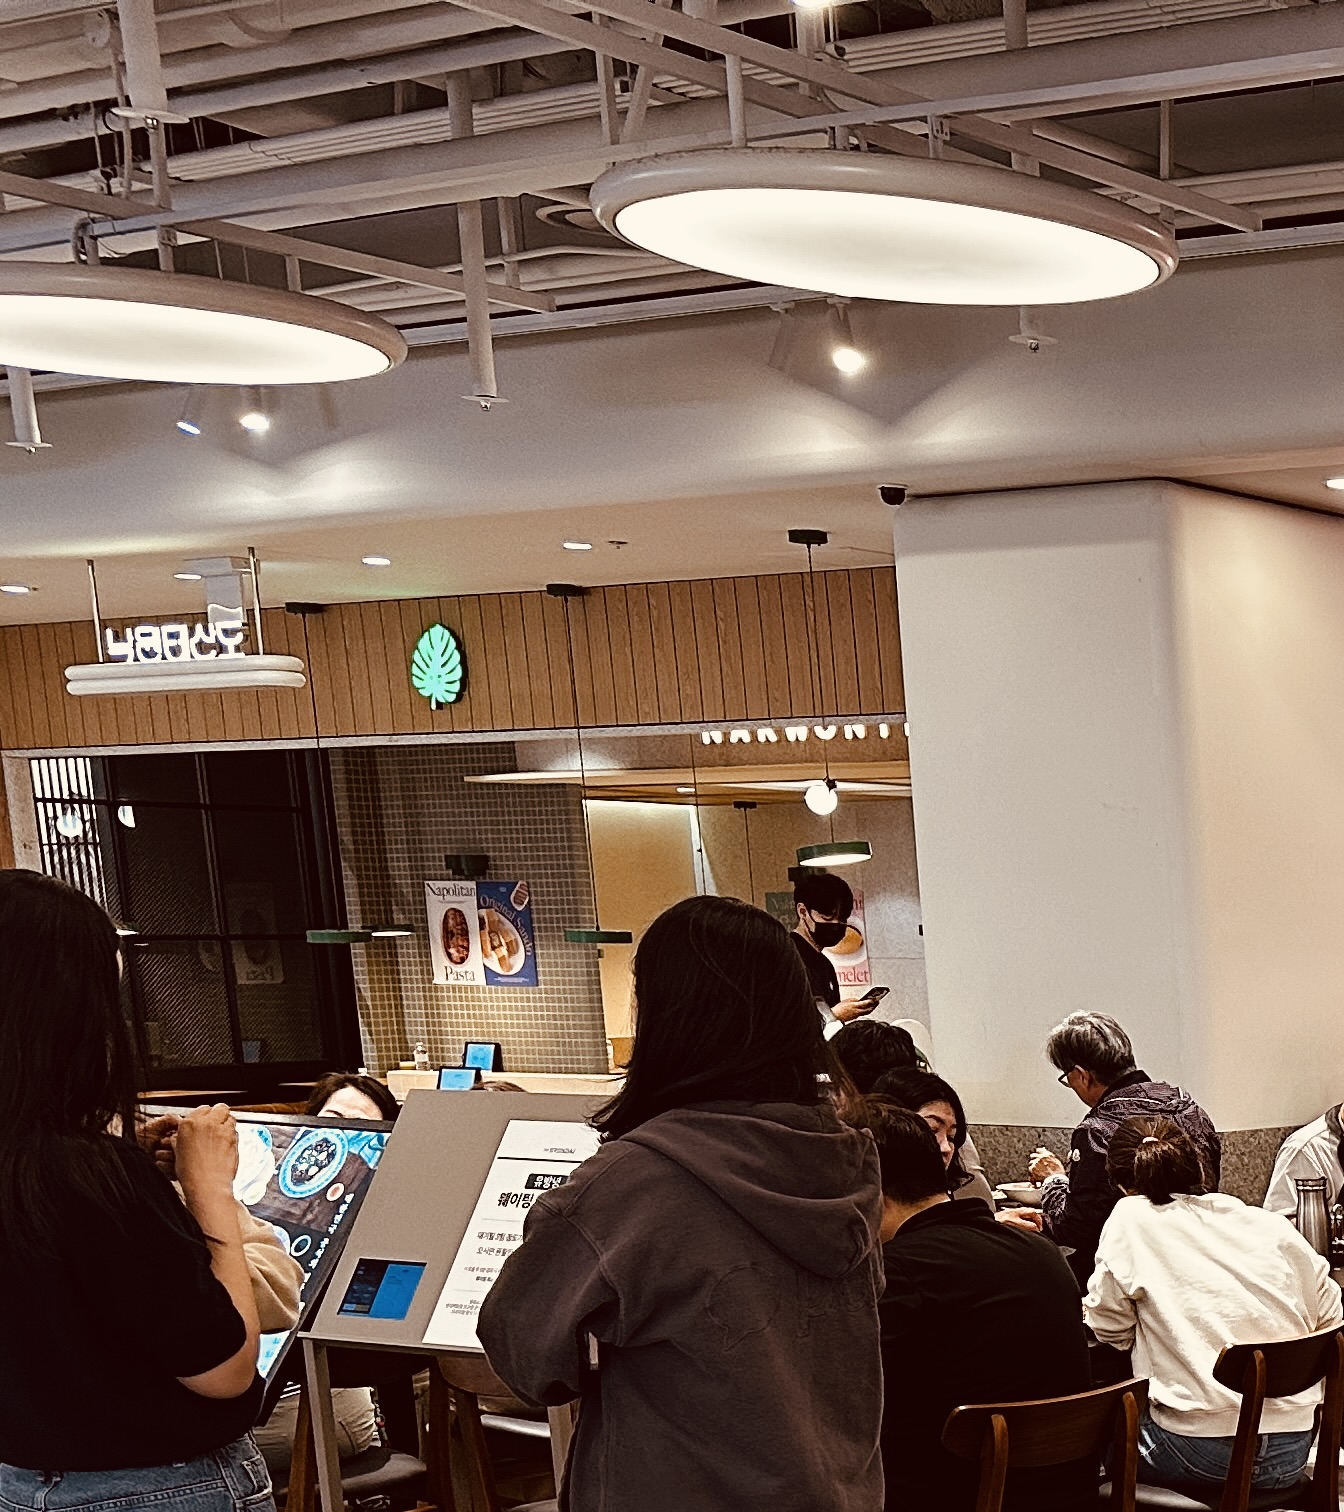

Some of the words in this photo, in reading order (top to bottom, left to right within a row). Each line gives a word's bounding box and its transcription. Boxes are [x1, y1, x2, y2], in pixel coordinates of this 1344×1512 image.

[426, 882, 476, 900] Napolitan
[480, 894, 516, 921] Original
[513, 915, 533, 956] Sando
[444, 965, 475, 982] Pasta
[836, 967, 869, 983] melet
